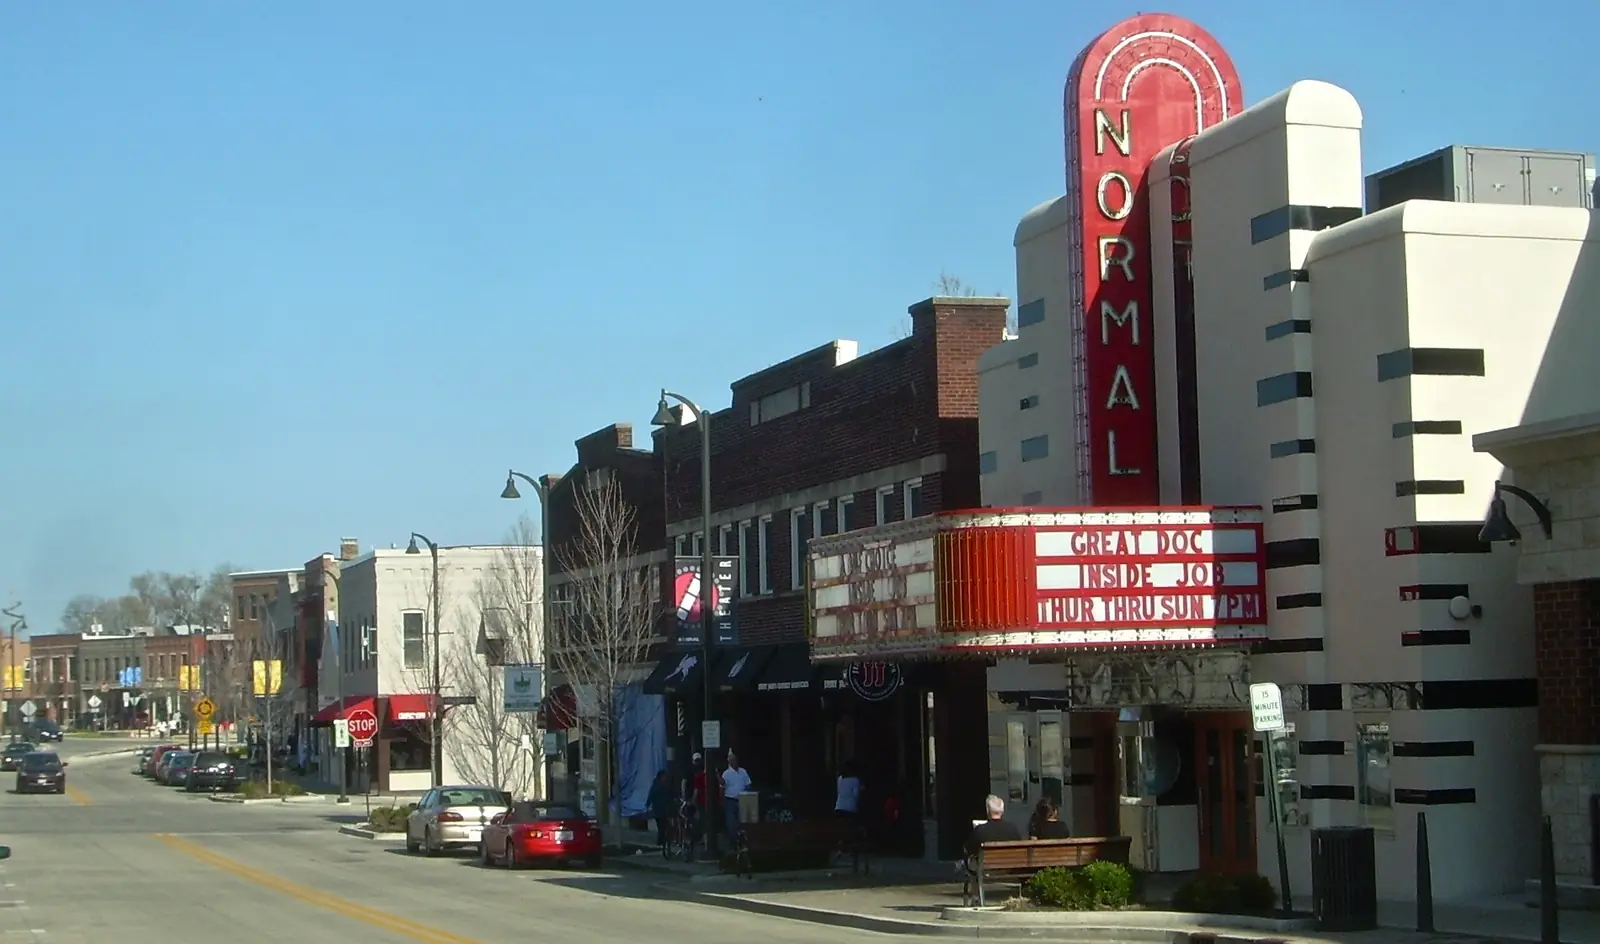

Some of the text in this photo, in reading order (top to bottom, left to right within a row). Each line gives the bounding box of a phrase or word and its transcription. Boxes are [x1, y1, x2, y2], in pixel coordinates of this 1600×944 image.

[1094, 108, 1141, 476] NORMAL
[1071, 530, 1203, 555] GREAT DOC
[1080, 562, 1225, 588] INSIDE JOB
[719, 560, 732, 641] THEATER
[1037, 596, 1094, 623] THUR
[1102, 595, 1155, 622] THRU
[1161, 594, 1204, 620] SUN
[1254, 701, 1279, 711] MINUTE
[1261, 689, 1270, 698] 15
[349, 719, 375, 732] STOP
[1254, 713, 1282, 723] PARKING
